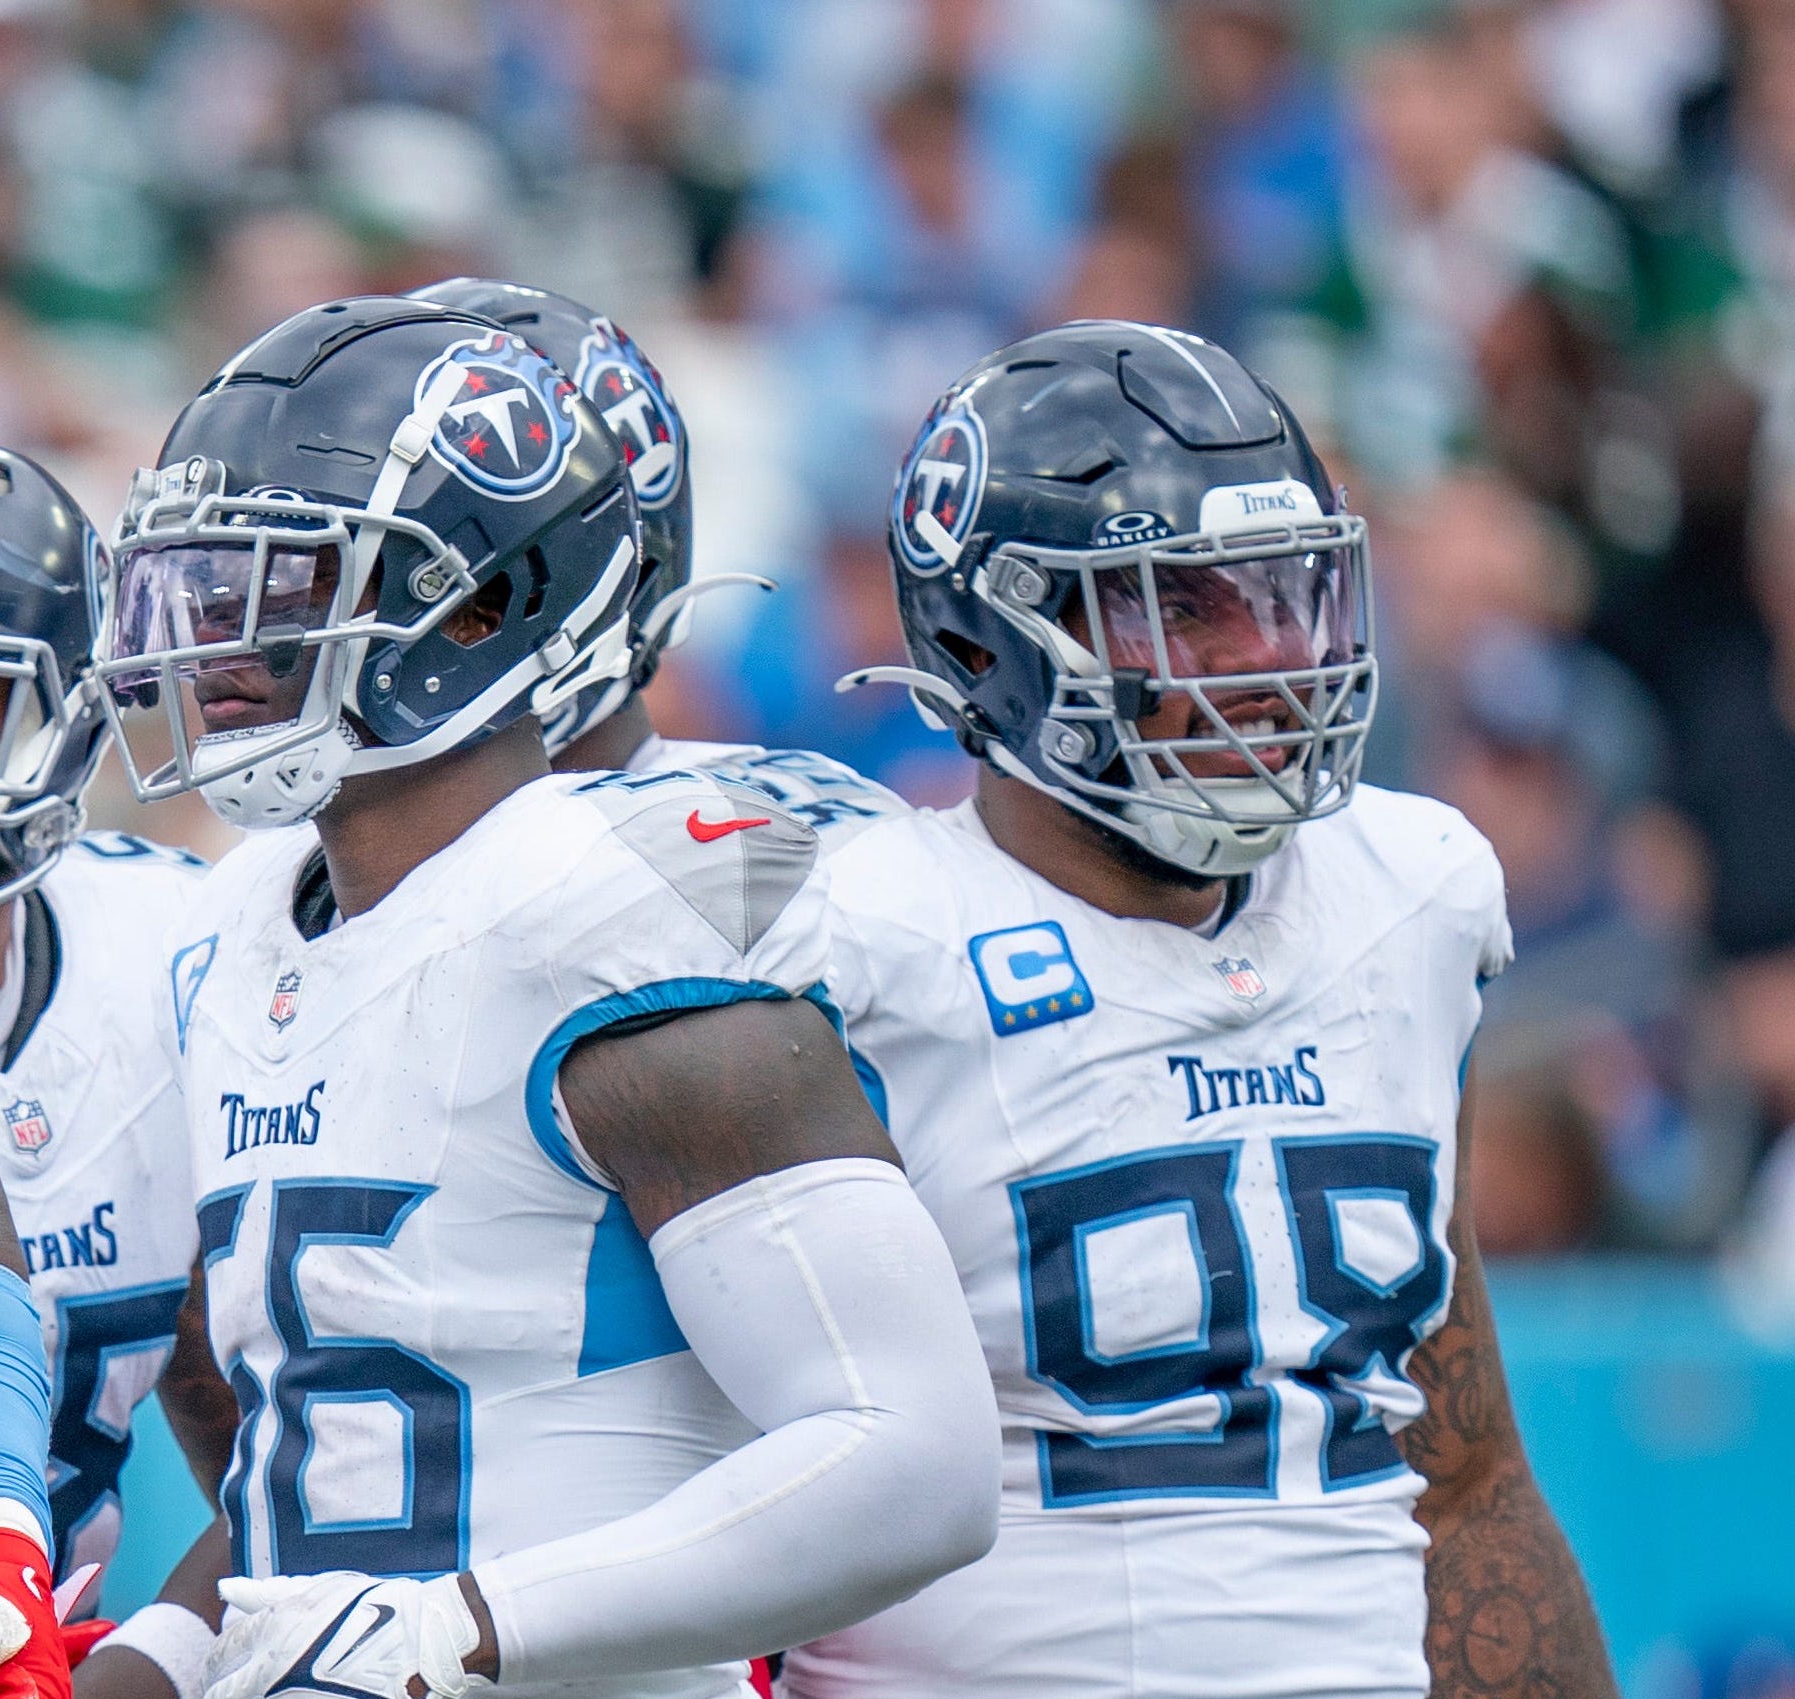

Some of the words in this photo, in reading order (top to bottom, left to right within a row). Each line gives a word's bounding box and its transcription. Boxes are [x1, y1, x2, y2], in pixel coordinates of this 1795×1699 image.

[449, 388, 530, 470] T
[1236, 488, 1296, 515] TITANS
[1097, 527, 1168, 546] OAKLEY
[271, 993, 296, 1017] NFL
[1229, 970, 1264, 997] NFL
[1168, 1046, 1326, 1122] TITANS
[14, 1115, 51, 1147] NFL
[220, 1079, 326, 1160] TITANS
[21, 1201, 120, 1275] TANS
[1008, 1132, 1455, 1509] 98
